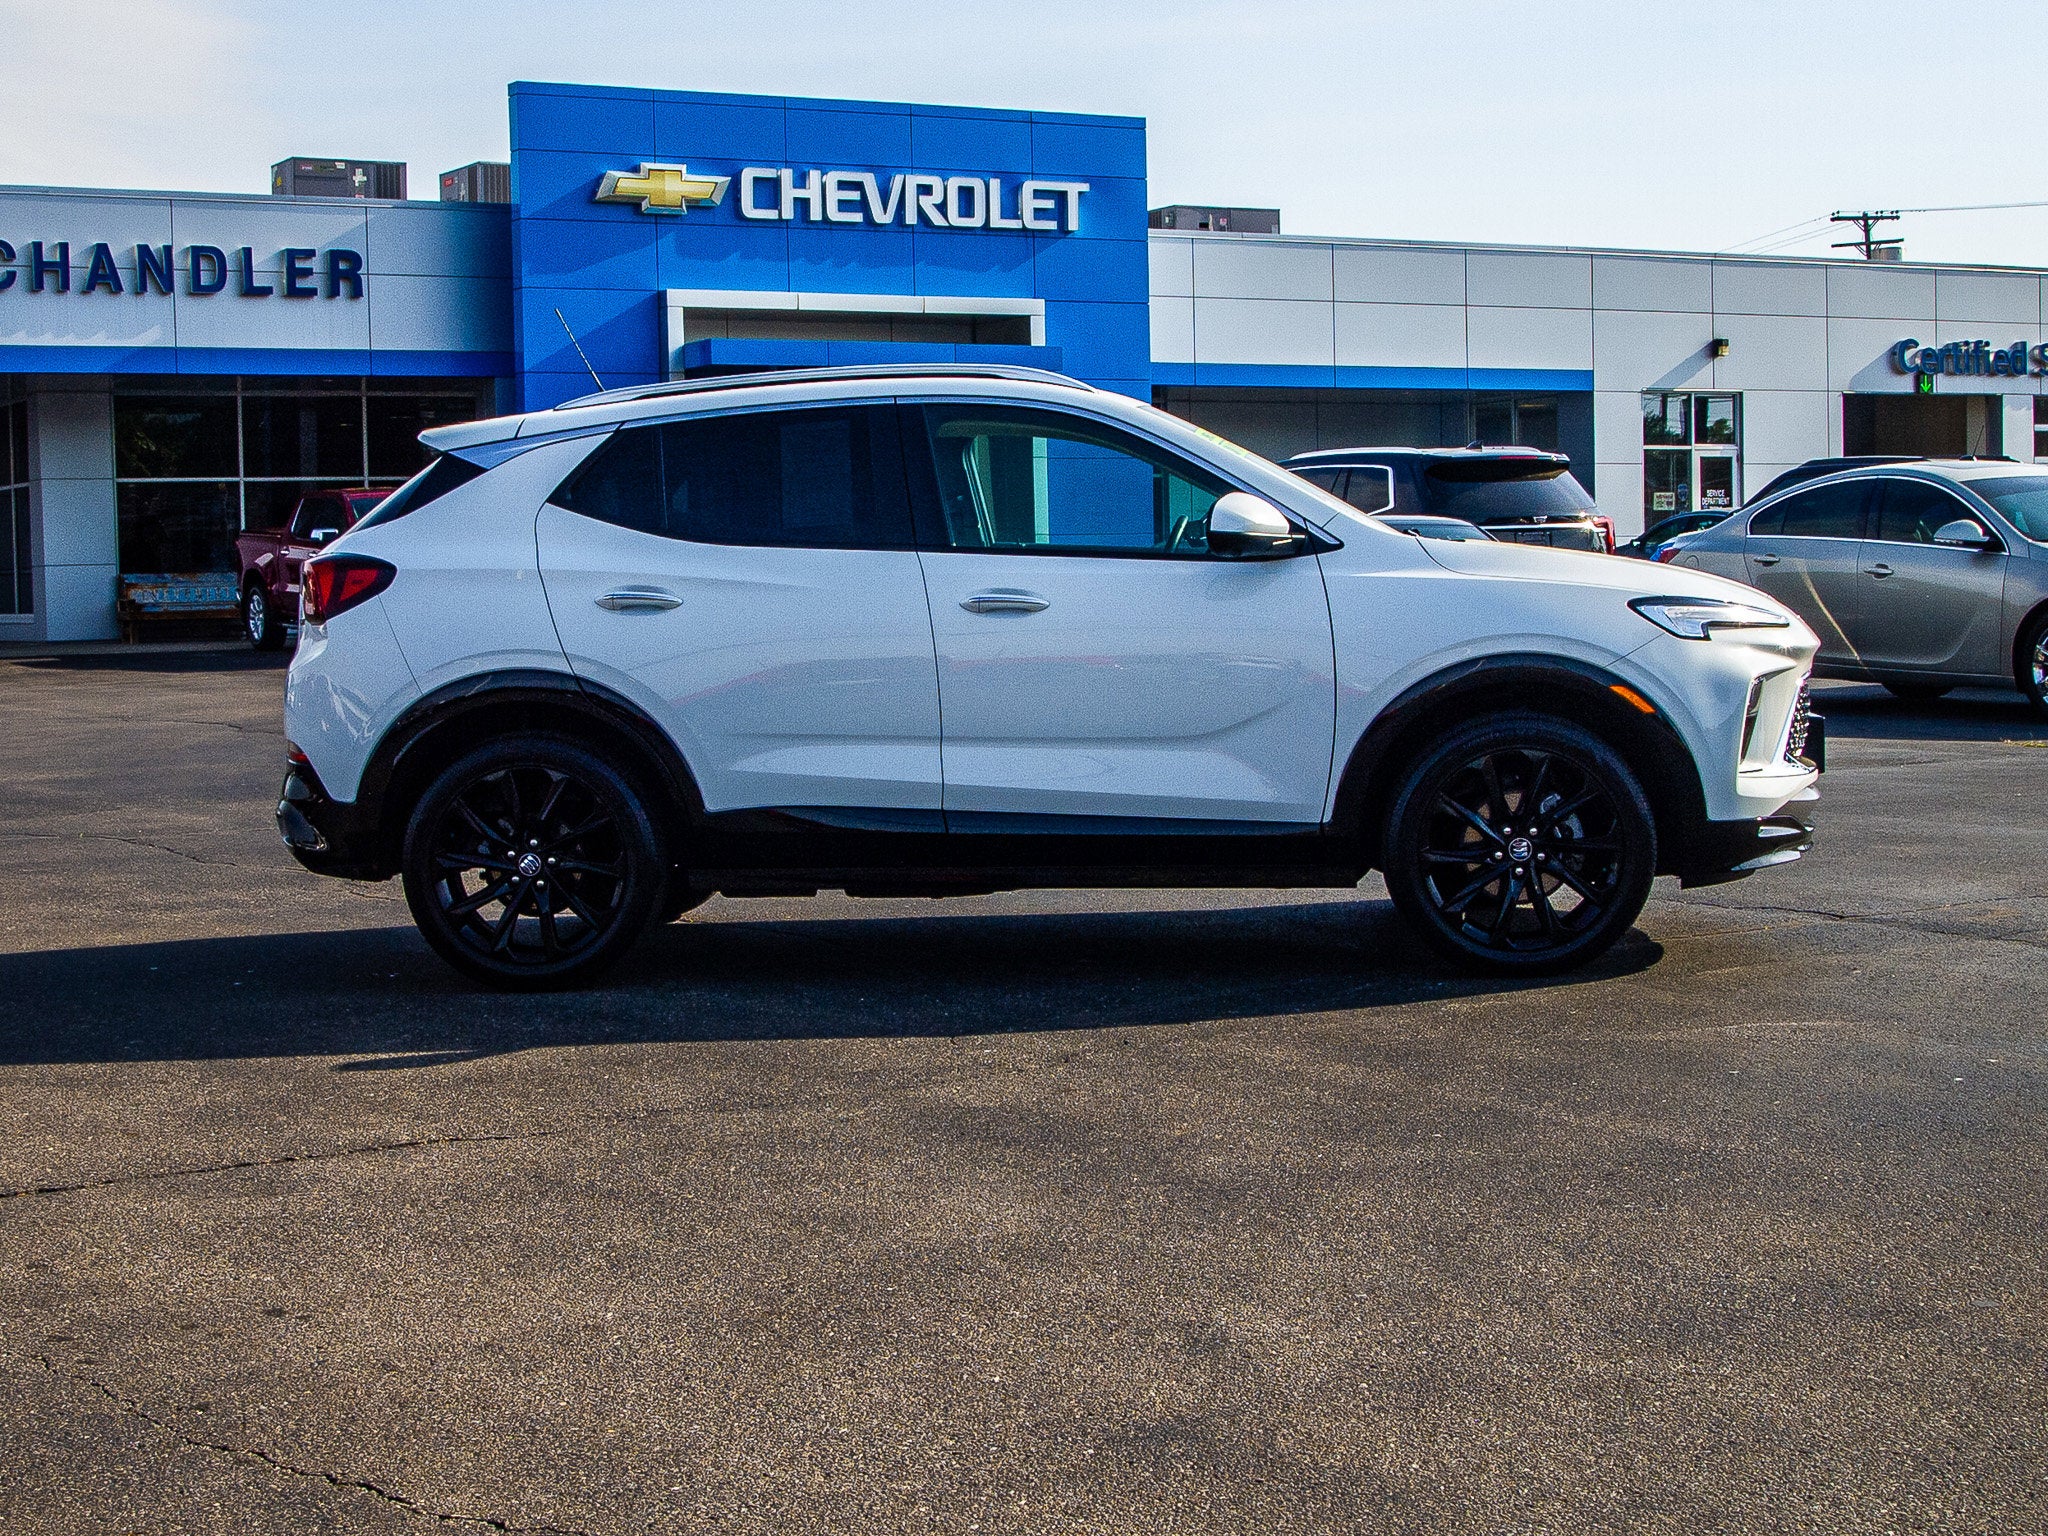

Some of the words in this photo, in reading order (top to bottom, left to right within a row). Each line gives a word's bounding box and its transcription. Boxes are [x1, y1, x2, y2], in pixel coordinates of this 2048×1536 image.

[740, 167, 1090, 232] CHEVROLET
[1892, 338, 2028, 376] Certified
[1701, 497, 1730, 505] DEPARTMENT
[1706, 489, 1725, 497] SERVICE
